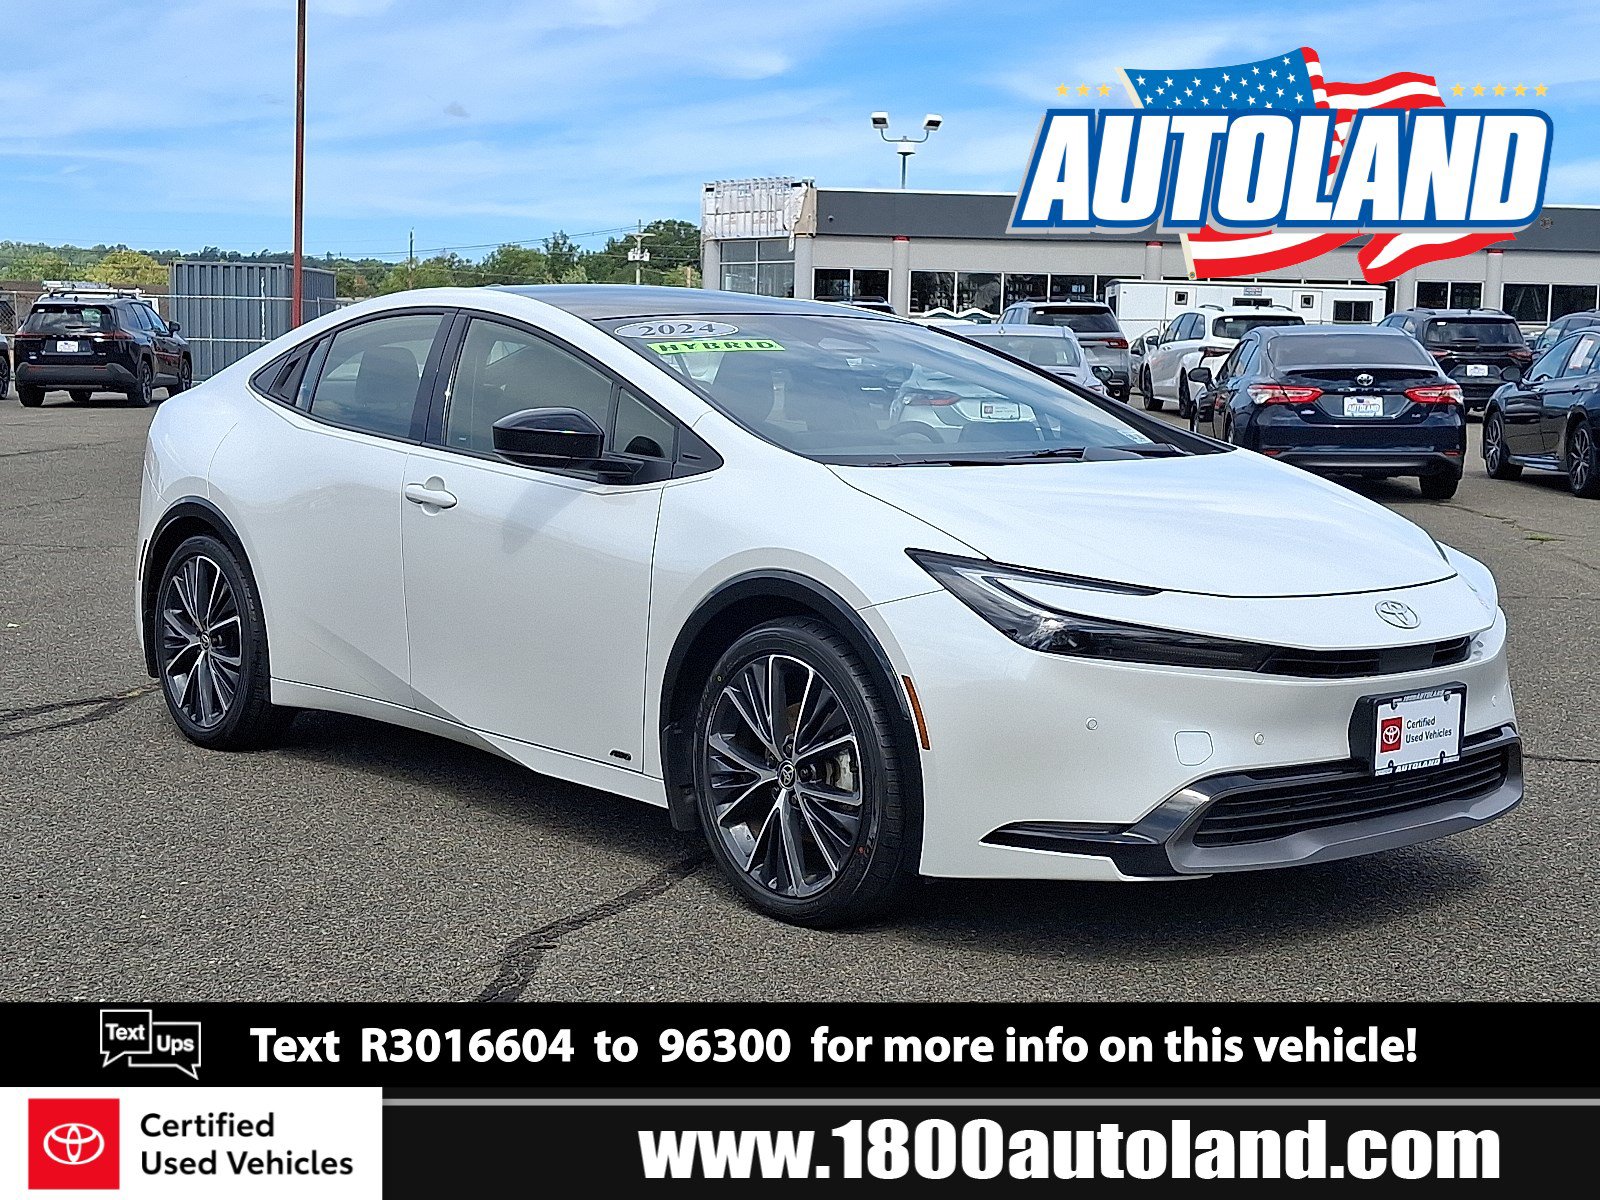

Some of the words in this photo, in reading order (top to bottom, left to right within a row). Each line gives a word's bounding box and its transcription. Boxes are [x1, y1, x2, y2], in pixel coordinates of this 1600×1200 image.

[638, 323, 716, 337] 2024
[658, 340, 775, 352] HYBRID
[1406, 716, 1436, 730] Certified
[1405, 732, 1424, 743] Used
[1424, 728, 1452, 740] Vehicles
[1395, 758, 1440, 773] AUTOLAND
